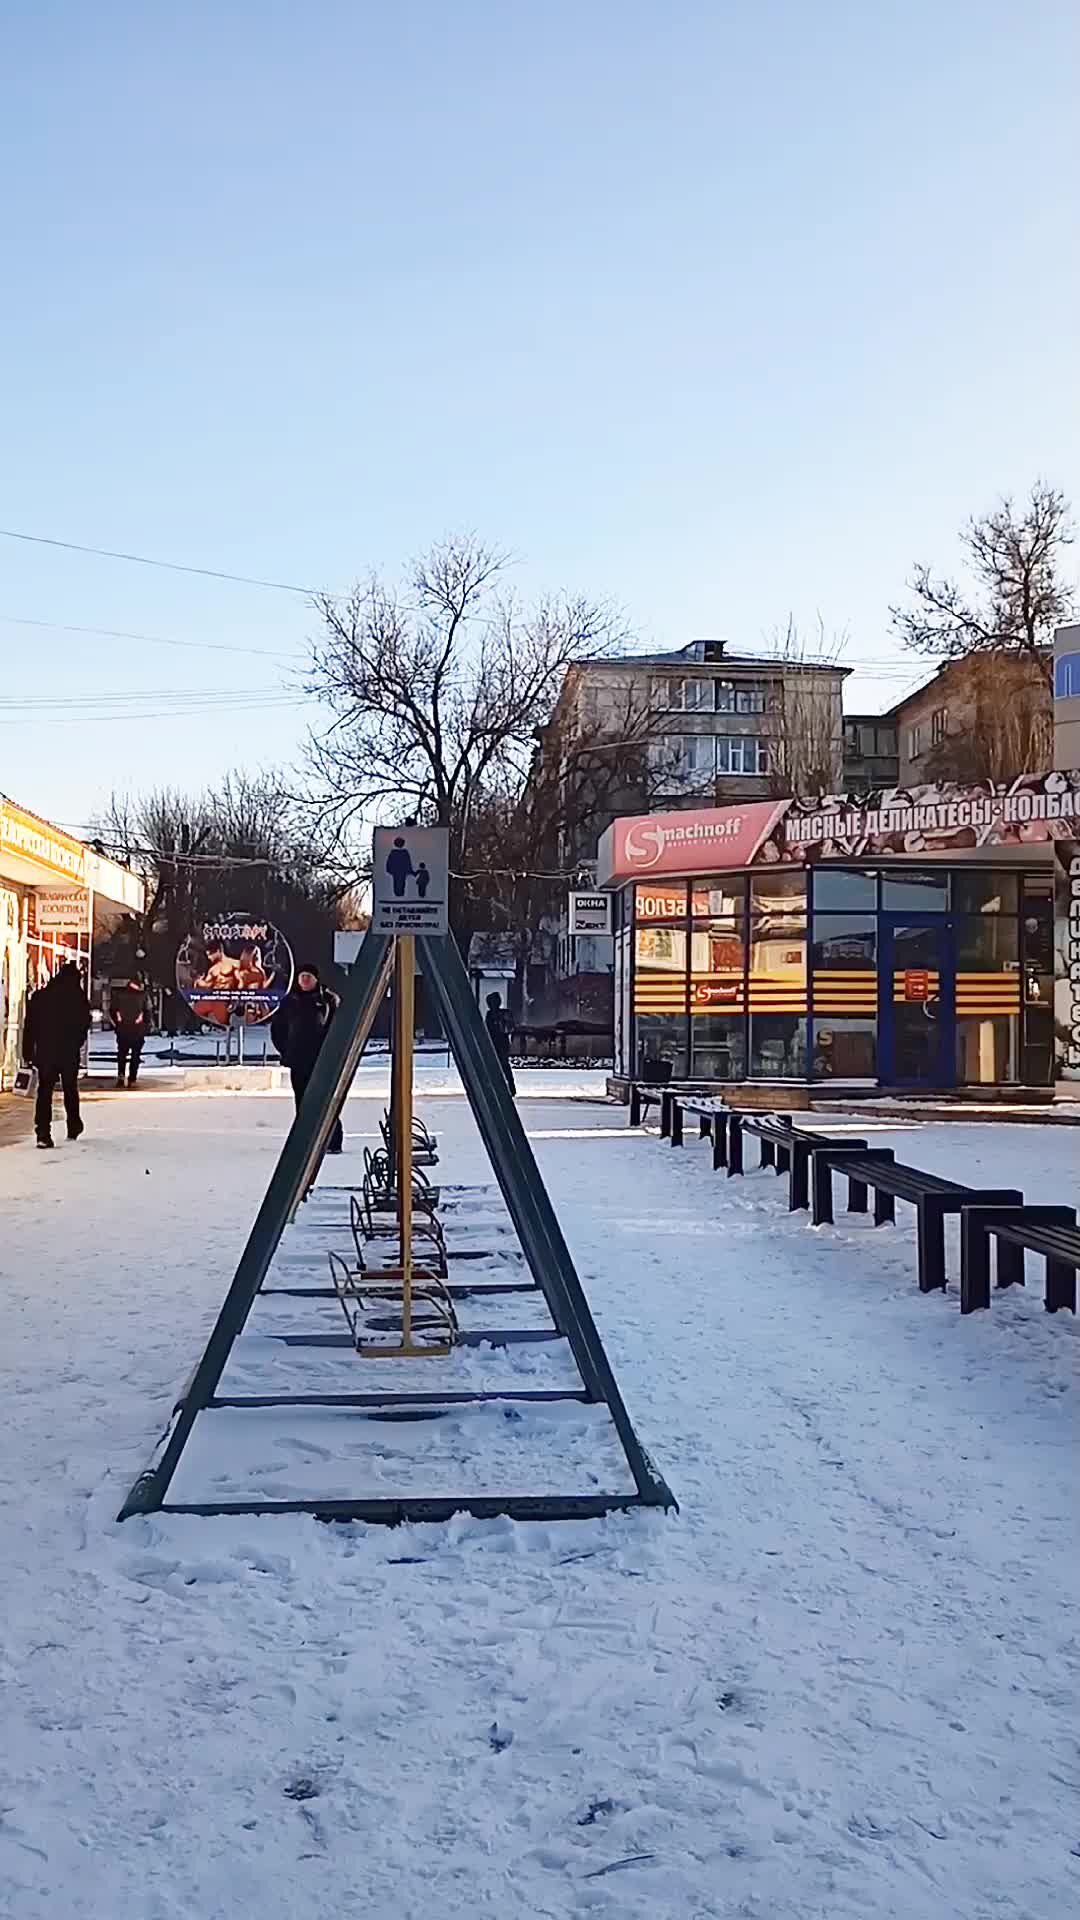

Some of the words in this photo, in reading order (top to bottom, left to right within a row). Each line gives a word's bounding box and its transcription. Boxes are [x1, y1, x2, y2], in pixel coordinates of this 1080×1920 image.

[785, 811, 861, 841] МЯСНЫЕ
[865, 799, 991, 838] ДЕЛИКАТЕСЫ
[577, 899, 606, 908] ОКНА
